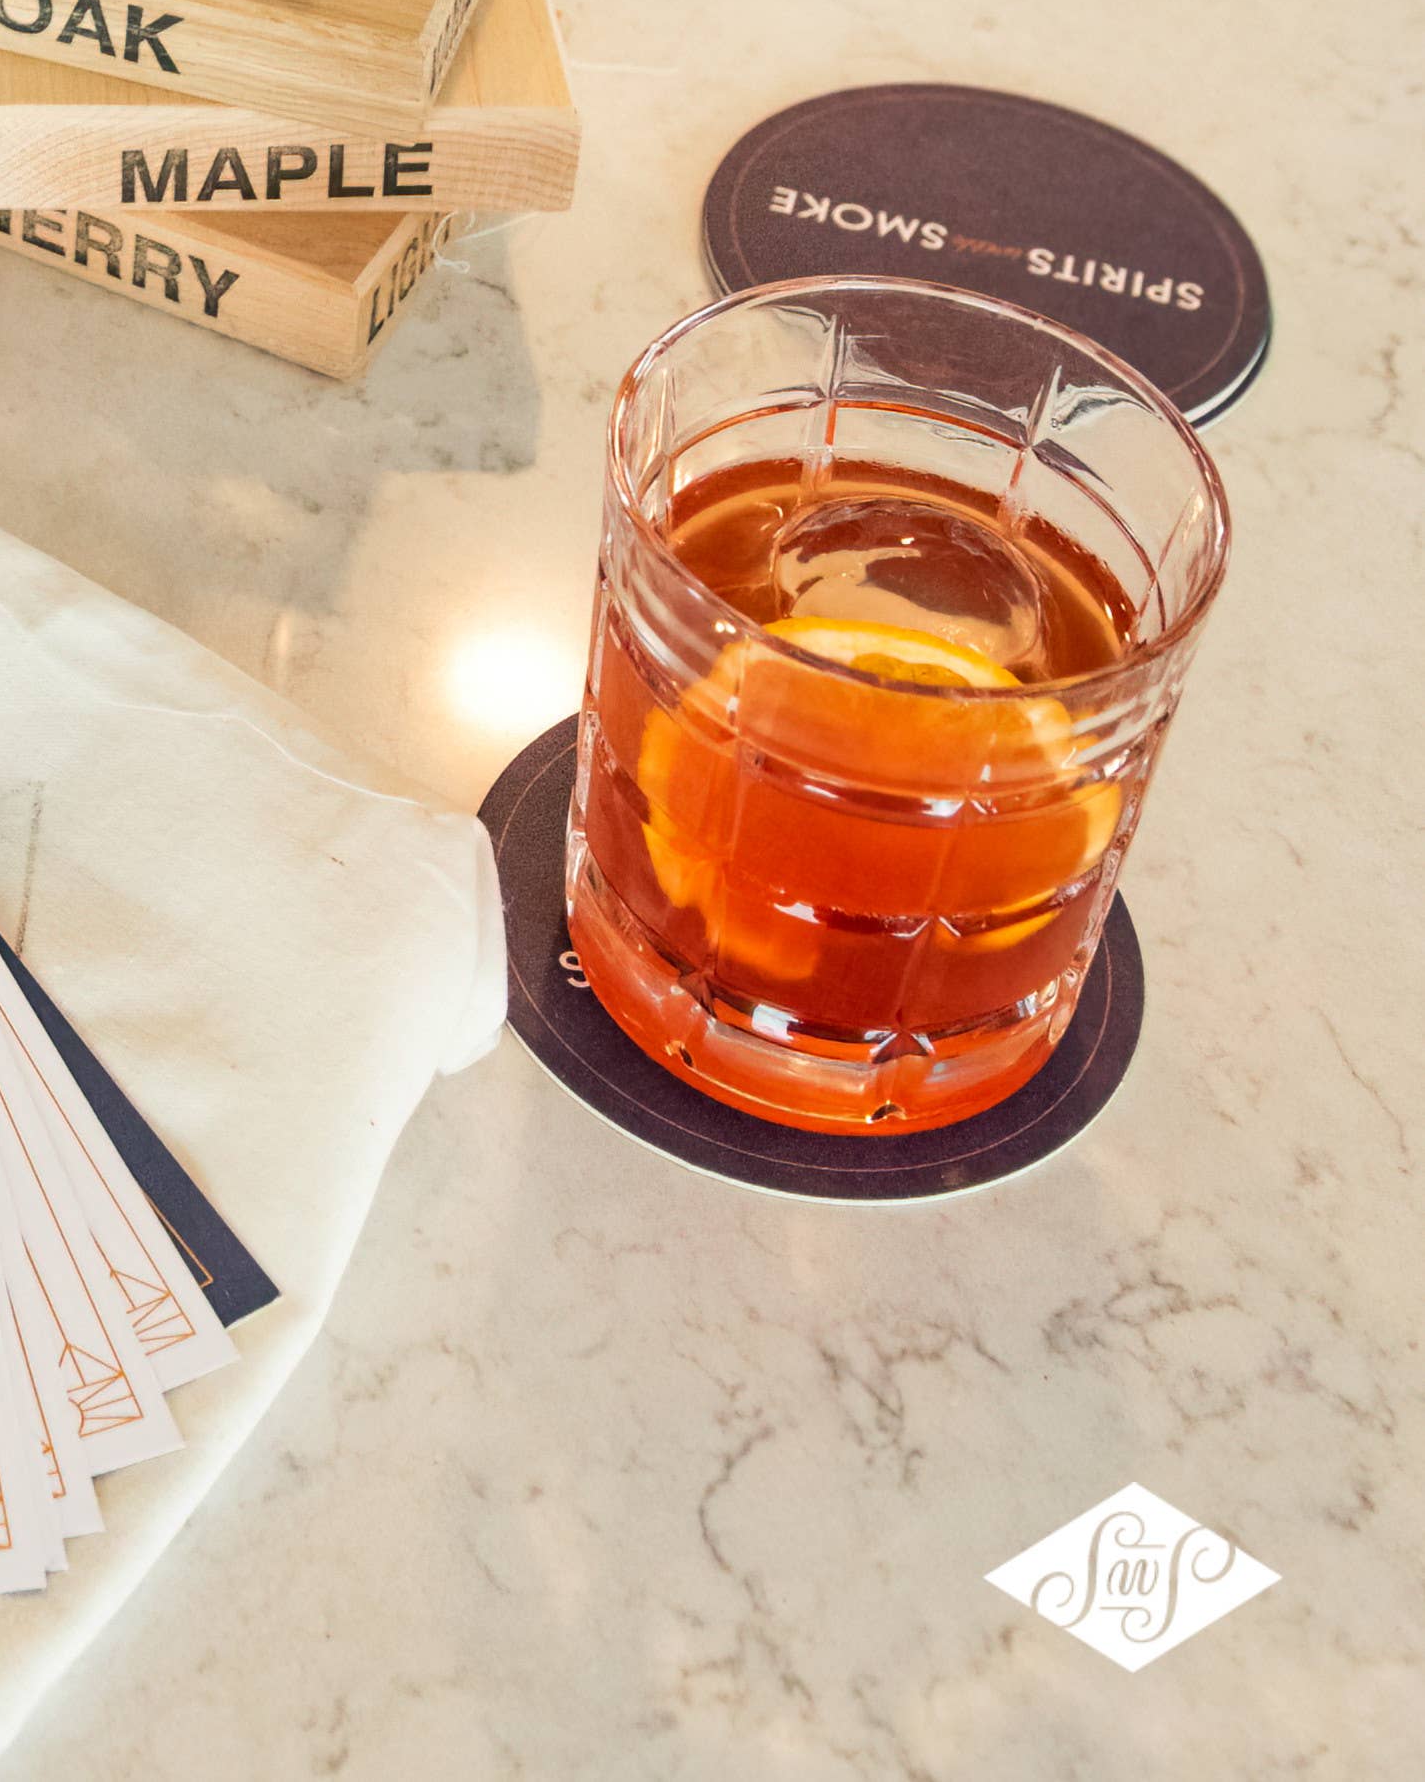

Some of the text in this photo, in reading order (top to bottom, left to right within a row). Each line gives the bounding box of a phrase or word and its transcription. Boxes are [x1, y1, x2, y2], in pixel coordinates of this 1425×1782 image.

[120, 141, 434, 204] MAPLE
[770, 186, 950, 252] SMOKE
[1026, 248, 1204, 312] SPIRITS
